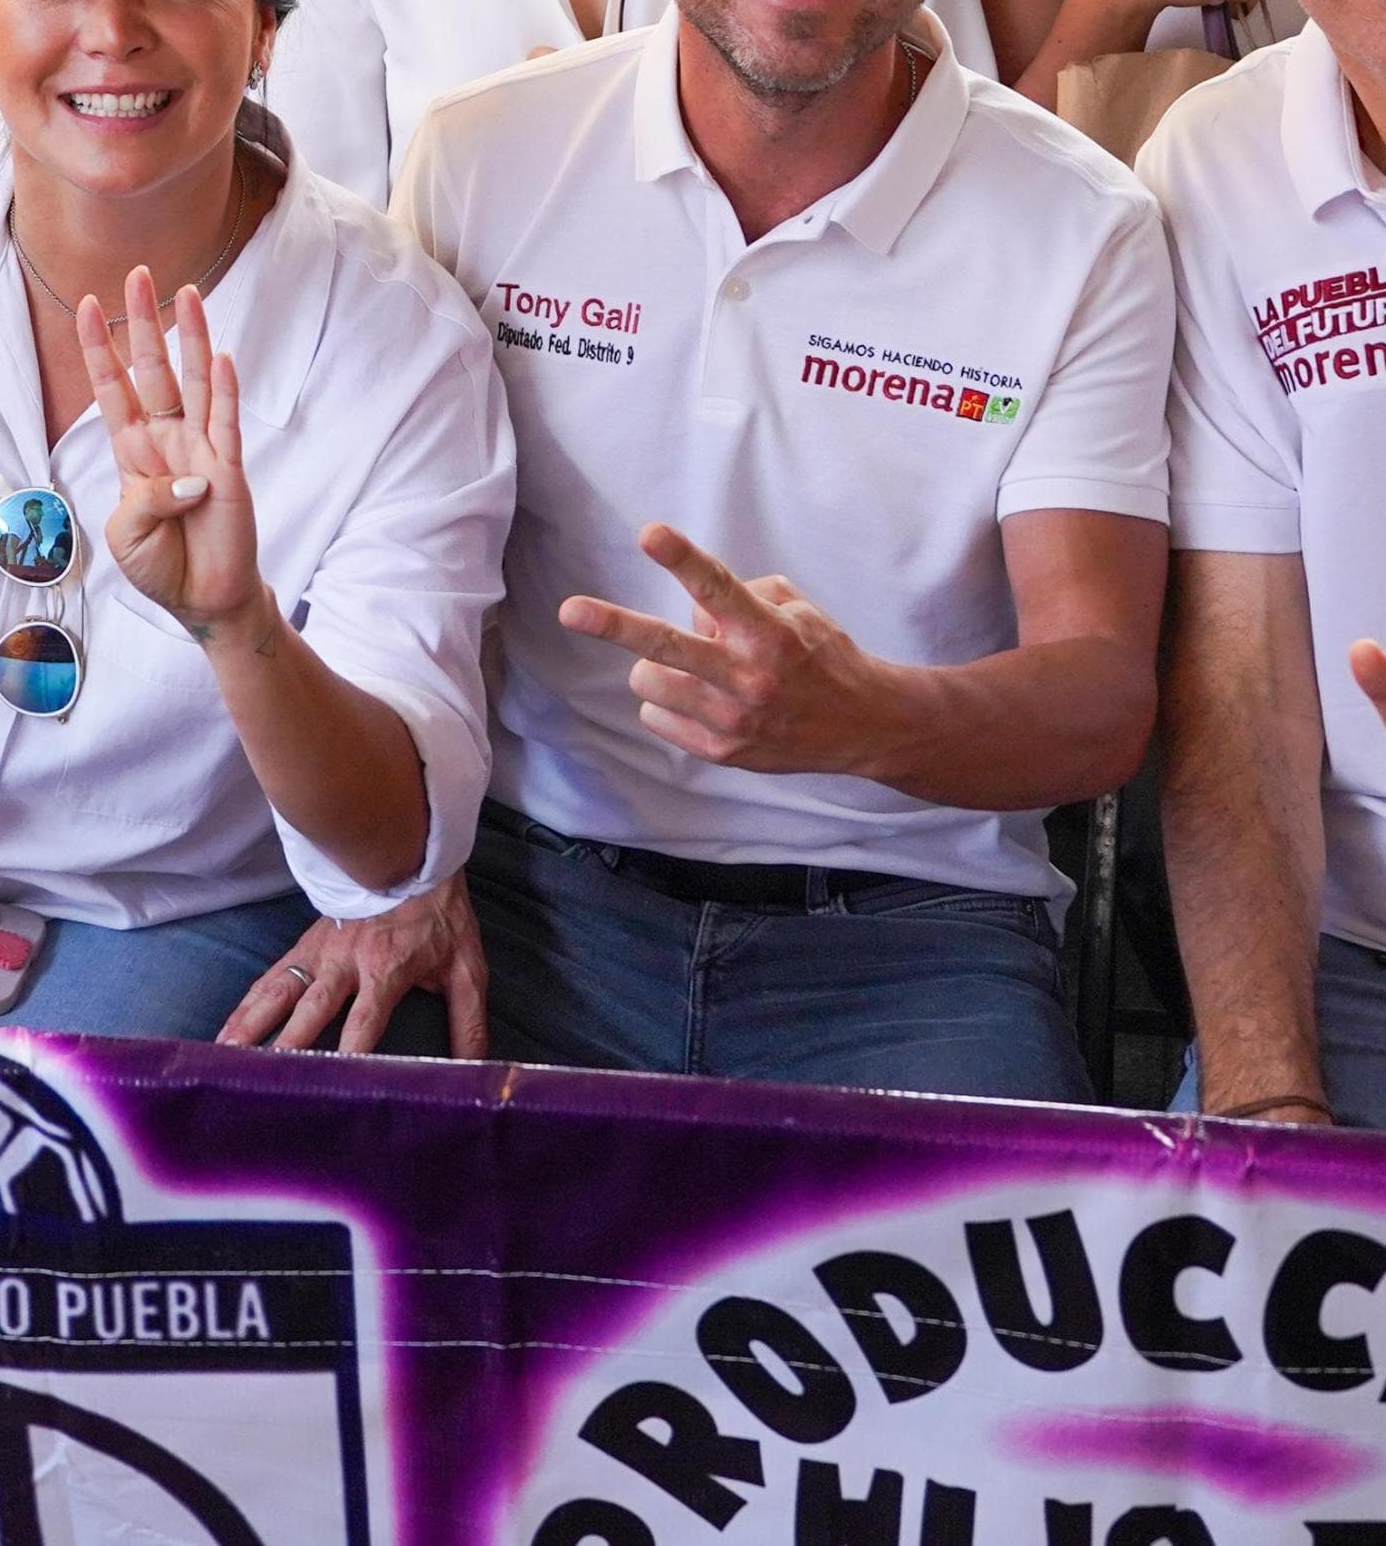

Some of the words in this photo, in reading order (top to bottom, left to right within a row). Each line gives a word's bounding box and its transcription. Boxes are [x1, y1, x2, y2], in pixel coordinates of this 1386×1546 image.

[496, 283, 571, 328] Tony
[581, 297, 641, 334] Gali
[1253, 297, 1279, 331] LA
[497, 322, 543, 352] Diputado
[577, 338, 622, 365] Distrito
[626, 345, 635, 365] 9
[808, 334, 875, 358] SIGAMOS
[882, 349, 954, 375] HACIENDO
[960, 366, 1023, 390] HISTORIA
[1262, 324, 1296, 363] DEL
[801, 355, 955, 413] morena
[960, 402, 984, 420] PT
[57, 1282, 270, 1339] PUEBLA
